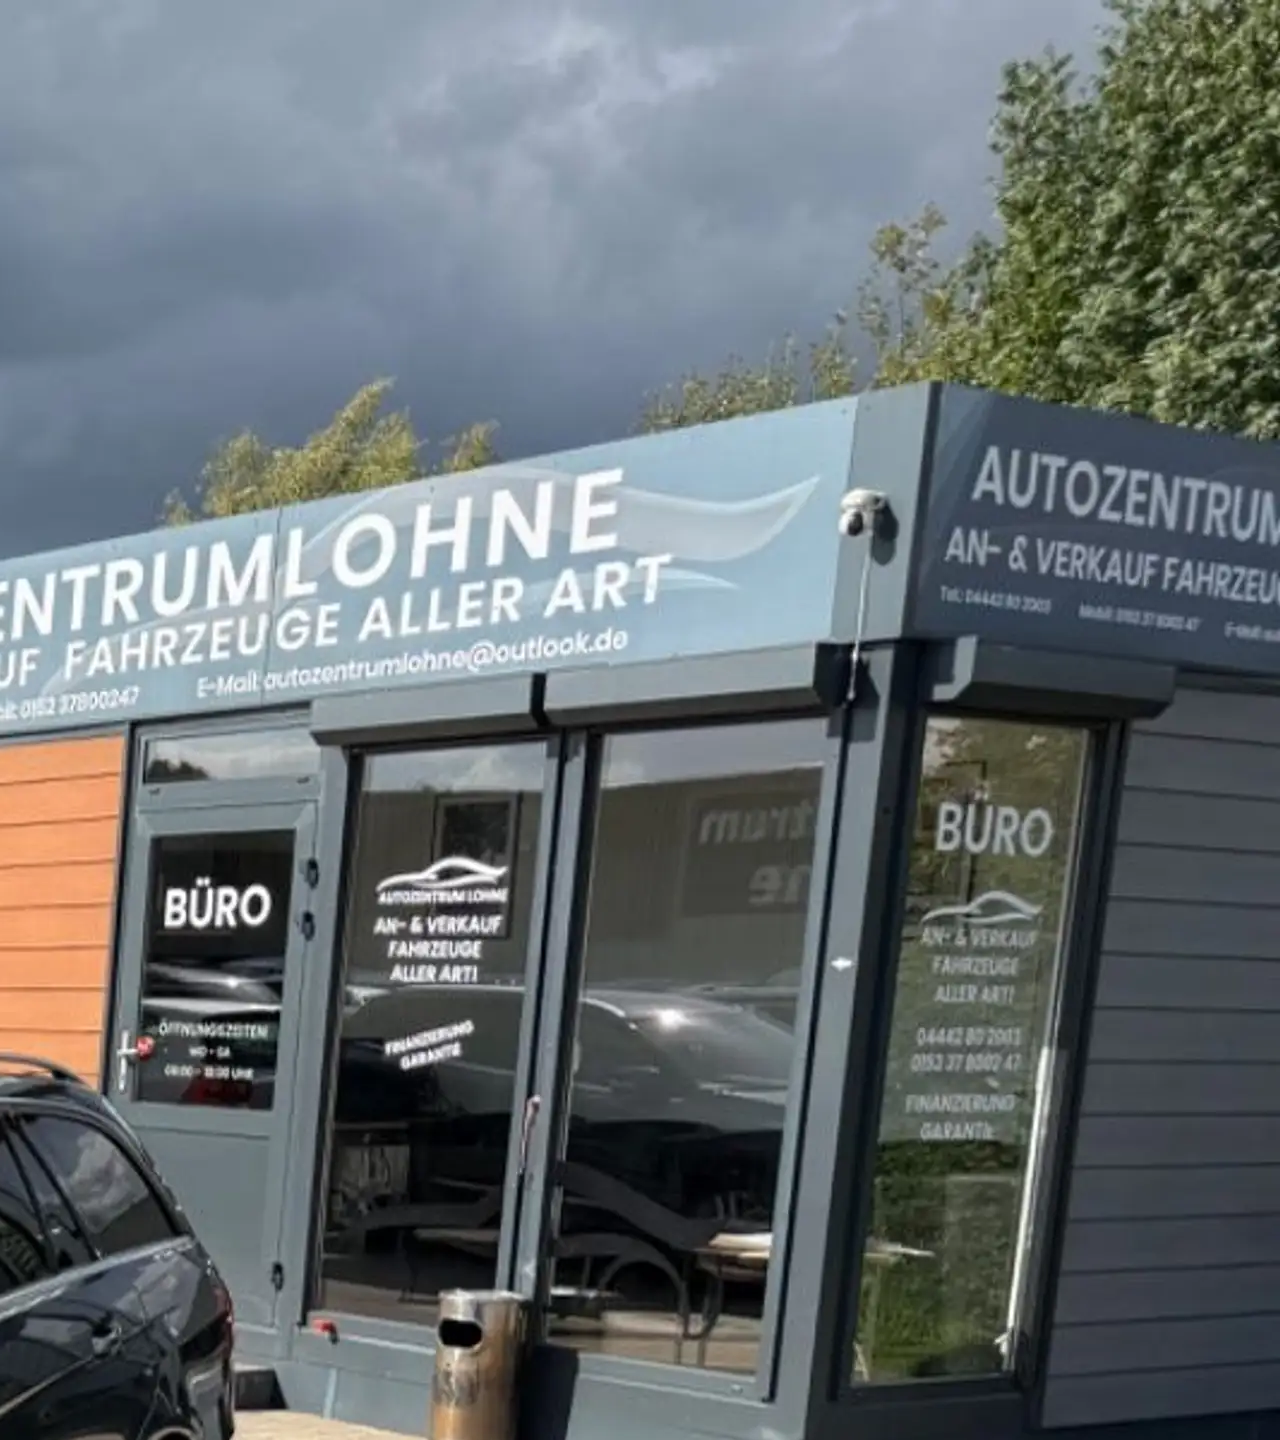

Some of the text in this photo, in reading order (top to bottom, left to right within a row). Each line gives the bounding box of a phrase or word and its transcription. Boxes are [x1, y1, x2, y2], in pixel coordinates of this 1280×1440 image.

[972, 445, 1280, 547] AUTOZENTRUM
[945, 527, 1280, 606] AN- & VERKAUF FAHRZEU
[64, 602, 341, 681] FAHRZEUGE
[359, 579, 525, 642] ALLER
[544, 553, 673, 618] ART
[263, 627, 629, 691] autozentrumlohne@outlook.de
[935, 789, 1054, 858] BÜRO
[164, 876, 271, 929] BÜRO
[373, 916, 407, 936] AN-
[427, 914, 503, 935] VERKAUF
[387, 940, 483, 960] FAHRZEUGE
[390, 964, 437, 983] ALLER
